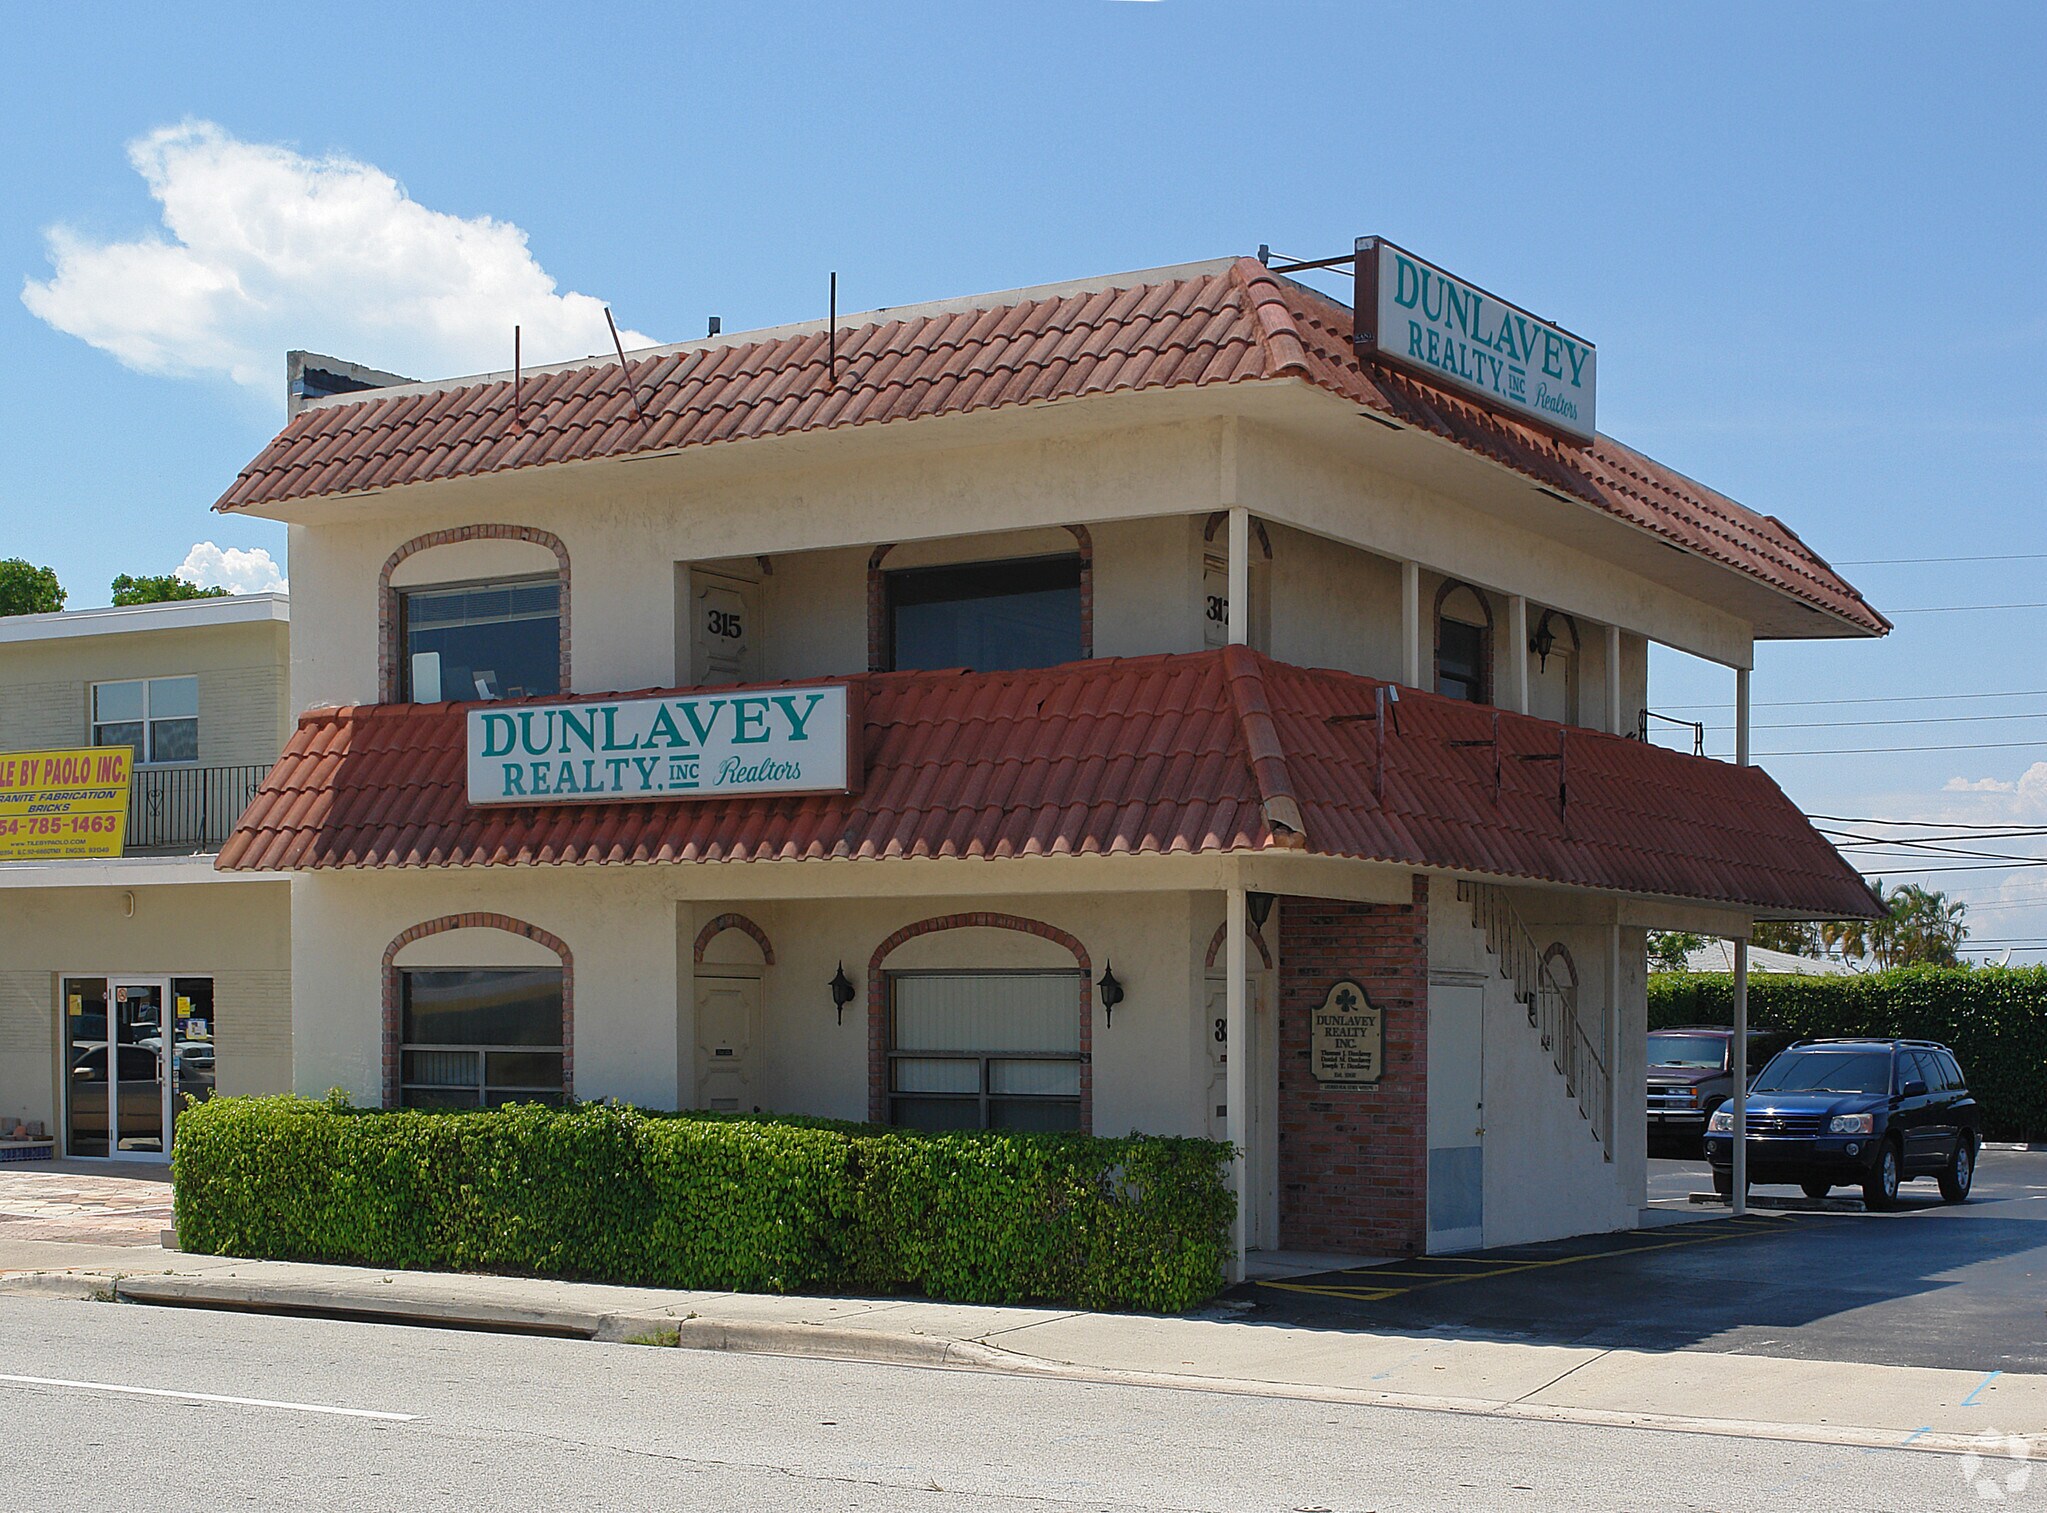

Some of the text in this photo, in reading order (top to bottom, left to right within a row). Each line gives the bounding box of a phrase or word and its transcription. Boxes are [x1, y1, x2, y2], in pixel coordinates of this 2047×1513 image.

[1394, 254, 1590, 388] DUNLAVEY
[1508, 373, 1526, 394] INC
[1534, 381, 1578, 421] Realtors
[708, 610, 742, 638] 315
[480, 693, 825, 757] DUNLAVEY
[20, 759, 40, 786] BY
[43, 756, 91, 785] PAOLO
[96, 755, 126, 783] INC.
[669, 763, 699, 781] INC
[713, 755, 802, 786] Realtors
[28, 803, 71, 813] BRICKS
[39, 791, 117, 801] FABRICATION
[1316, 1016, 1376, 1027] DUNLAVEY
[1325, 1027, 1367, 1037] REALTY
[1335, 1039, 1357, 1049] INC.
